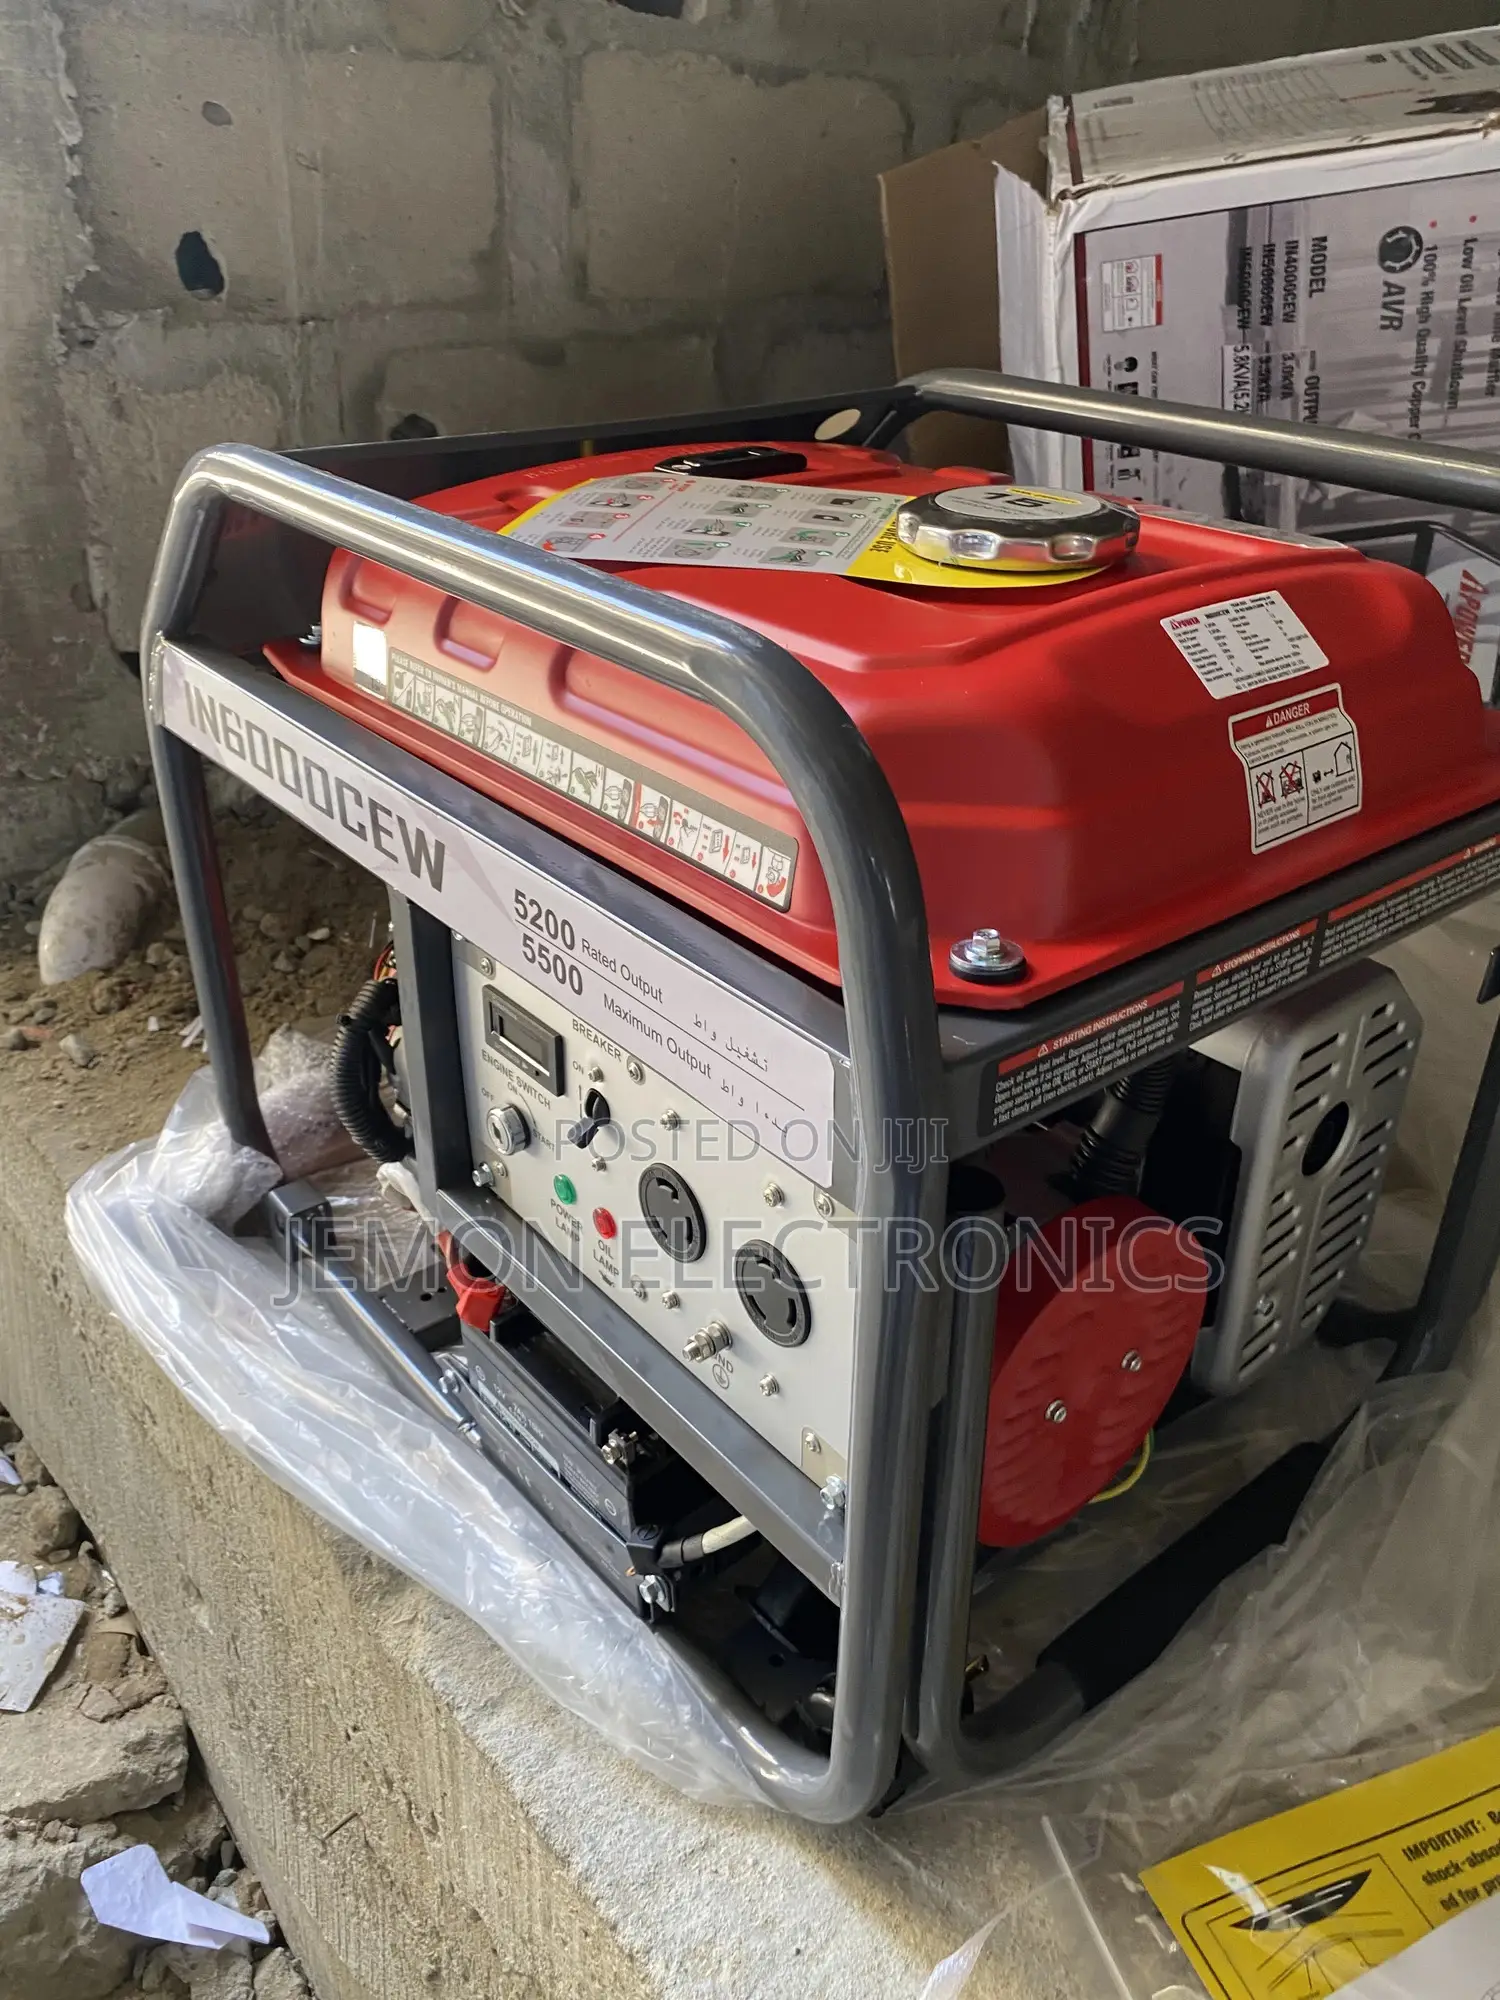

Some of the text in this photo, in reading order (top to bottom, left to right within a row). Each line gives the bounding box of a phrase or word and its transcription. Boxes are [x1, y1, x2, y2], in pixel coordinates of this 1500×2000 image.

[1282, 240, 1299, 323] IN4000CEW
[1309, 236, 1327, 298] MODEL
[1421, 244, 1439, 287] 100%
[1380, 280, 1407, 331] AVR
[1417, 291, 1434, 324] High
[1447, 238, 1478, 410] Low Oil Level Shutdown
[1411, 329, 1431, 377] Quality
[1407, 381, 1426, 428] Copper
[391, 652, 409, 668] PLEASE
[410, 662, 424, 674] REFER
[425, 669, 432, 678] TO
[457, 682, 479, 701] MANUAL
[480, 693, 500, 711] BEFORE
[500, 703, 532, 726] OPERATION
[1272, 703, 1310, 723] DANGER
[185, 680, 446, 893] IN6000CEW
[513, 888, 664, 1004] 5200 Rated Output
[1224, 930, 1298, 971] STOPPING INSTRUCTIONS
[521, 933, 712, 1080] 5500 Maximum Output
[1054, 1000, 1146, 1048] STARTING INSTRUCTIONS
[572, 1019, 623, 1062] BREAKER
[996, 1075, 1013, 1092] Check
[1025, 1065, 1037, 1078] and
[1039, 1059, 1050, 1072] fuel
[1069, 1038, 1097, 1058] Disconnect
[1143, 1011, 1154, 1024] load
[1156, 1005, 1168, 1018] from
[481, 1049, 514, 1082] ENGINE
[516, 1075, 551, 1110] SWITCH
[507, 1080, 518, 1095] ON
[573, 1060, 584, 1075] ON
[994, 1099, 1013, 1115] engine
[1015, 1089, 1033, 1104] switch
[1041, 1080, 1051, 1092] the
[1085, 1056, 1102, 1071] START
[995, 1088, 1010, 1103] Open
[1011, 1082, 1022, 1095] fuel
[1024, 1076, 1038, 1089] valve
[1080, 1048, 1097, 1063] Adjust
[1098, 1041, 1114, 1055] choke
[481, 1087, 494, 1102] OFF
[999, 1110, 1009, 1123] fast
[1030, 1095, 1041, 1107] pull
[532, 1128, 555, 1154] START
[550, 1198, 583, 1230] POWER
[555, 1215, 580, 1243] LAMP
[593, 1249, 620, 1277] LAMP
[598, 1239, 614, 1260] OIL
[713, 1349, 734, 1374] ND
[1402, 1819, 1485, 1862] IMPORTANT:
[1458, 1886, 1482, 1906] for
